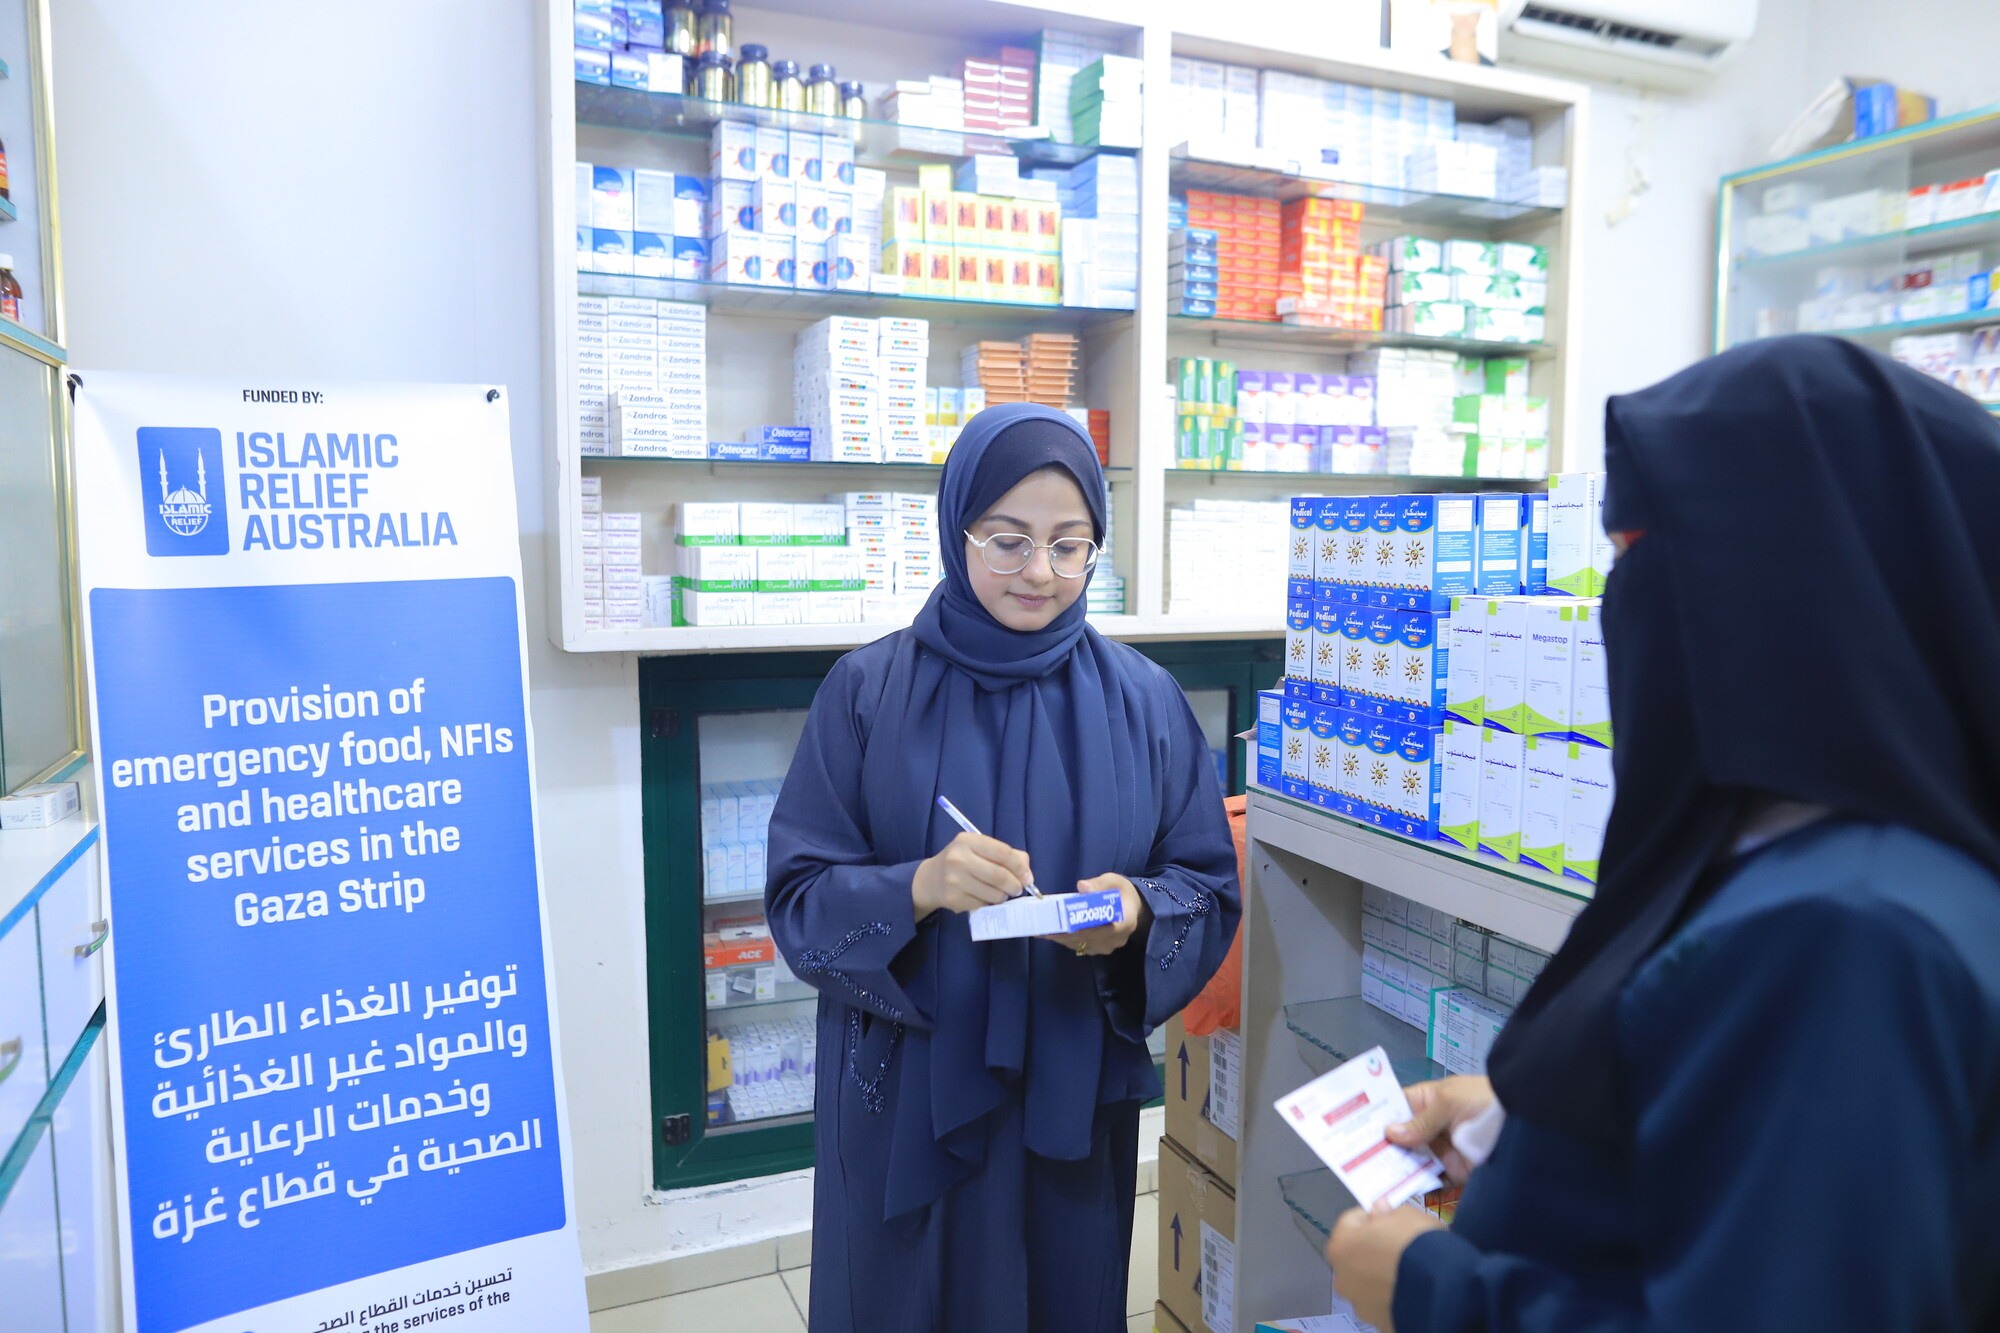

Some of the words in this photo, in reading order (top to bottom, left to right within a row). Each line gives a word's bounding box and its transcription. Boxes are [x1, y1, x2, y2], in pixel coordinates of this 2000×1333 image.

[243, 389, 298, 403] FUNDED
[302, 390, 323, 404] BY:
[580, 399, 603, 407] ndros
[629, 394, 663, 403] Zandros
[581, 415, 603, 423] ndros
[633, 412, 667, 420] Zandros
[633, 428, 667, 437] Zandros
[772, 428, 810, 437] Osteocare
[237, 431, 399, 469] ISLAMIC
[634, 445, 667, 453] Zandros
[718, 445, 758, 455] Osteocare
[769, 445, 808, 454] Osteocare
[239, 473, 369, 510] RELIEF
[159, 503, 212, 515] ISLAMIC
[1293, 508, 1312, 517] Pedical
[171, 518, 202, 526] RELIEF
[243, 511, 458, 551] AUSTRALIA
[1289, 610, 1309, 618] Pedical
[1316, 612, 1336, 622] Pedical
[1490, 630, 1522, 640] ميجاستوب
[1532, 633, 1568, 645] Megastop
[1580, 638, 1606, 646] استوب
[203, 684, 380, 729] Provision
[388, 677, 425, 715] of
[1285, 708, 1306, 718] Pedical
[112, 743, 331, 788] emergency
[339, 726, 431, 767] food,
[440, 723, 514, 758] NFIs
[1446, 750, 1476, 760] ميجاستوب
[1485, 758, 1517, 769] ميجاستوب
[1529, 766, 1564, 779] ميجاستوب
[1571, 776, 1608, 790] ميجاستوب
[178, 790, 252, 833] and
[262, 779, 462, 824] healthcare
[188, 835, 351, 883] services
[360, 827, 393, 862] in
[401, 820, 461, 856] the
[235, 891, 329, 927] Gaza
[339, 871, 426, 913] Strip
[1069, 905, 1115, 925] Osteocare
[737, 949, 763, 960] ACE
[424, 964, 518, 1020] توفير
[300, 981, 410, 1030] الغذاء
[155, 1002, 286, 1069] الطارئ
[396, 1020, 528, 1072] والمواد
[327, 1040, 386, 1093] غير
[152, 1053, 314, 1121] الغذائية
[348, 1079, 491, 1132] وخدمات
[205, 1105, 336, 1167] الرعاية
[418, 1119, 542, 1175] الصحية
[346, 1145, 409, 1206] في
[239, 1161, 336, 1229] قطاع
[153, 1187, 227, 1243] غزة
[465, 1267, 513, 1296] تحسين
[412, 1281, 461, 1306] خدمات
[359, 1295, 408, 1327] القطاع
[403, 1303, 465, 1330] services
[469, 1295, 484, 1312] of
[487, 1290, 511, 1307] the
[313, 1310, 355, 1333] الصح
